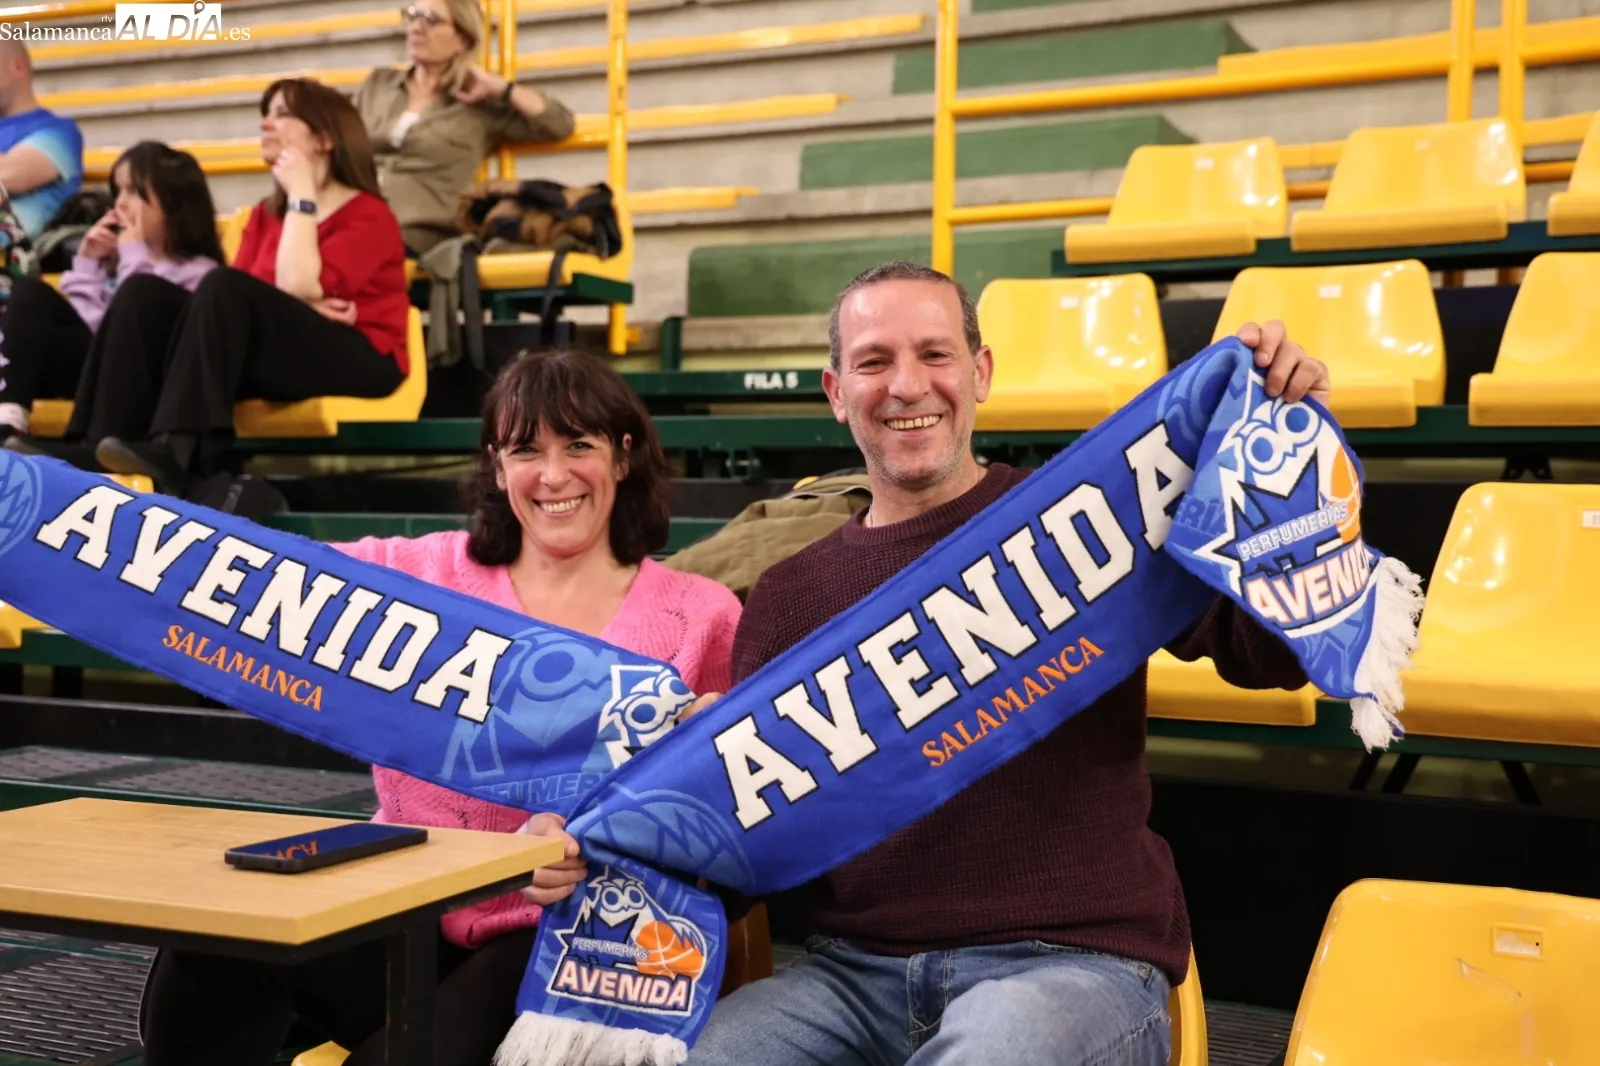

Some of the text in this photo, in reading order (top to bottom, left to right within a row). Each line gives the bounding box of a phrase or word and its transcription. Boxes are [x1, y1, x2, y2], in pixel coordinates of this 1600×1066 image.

[744, 371, 799, 389] FILA 5
[34, 484, 514, 724] AVENIDA
[712, 418, 1195, 833] AVENIDA
[162, 624, 324, 713] SALAMANCA
[922, 635, 1106, 769] SALAMANCA
[556, 959, 690, 1009] AVENIDA
